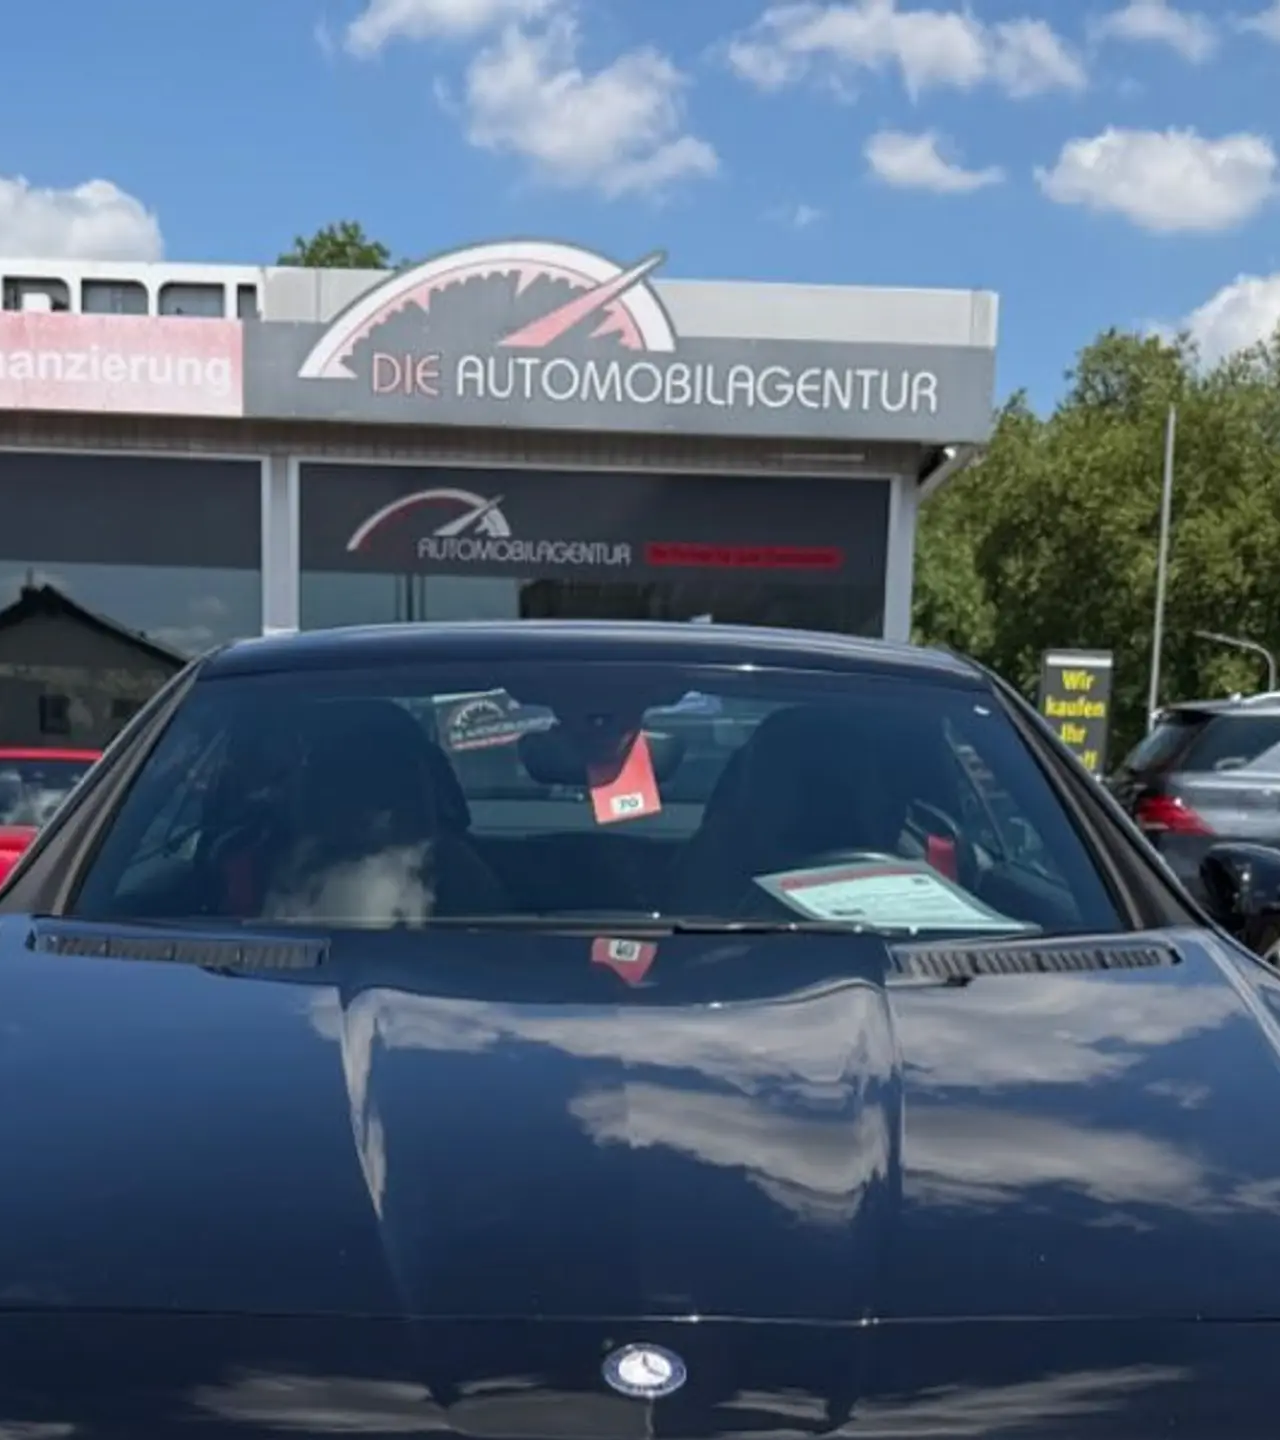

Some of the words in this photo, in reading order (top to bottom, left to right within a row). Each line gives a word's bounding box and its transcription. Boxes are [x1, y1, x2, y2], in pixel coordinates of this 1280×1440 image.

[371, 352, 440, 396] DIE
[456, 355, 939, 413] AUTOMOBILAGENTUR
[418, 536, 631, 566] AUTOMOBILAGENTUR
[1062, 669, 1094, 692] Wir
[1045, 694, 1106, 717] kaufen
[1061, 722, 1086, 744] Ihr
